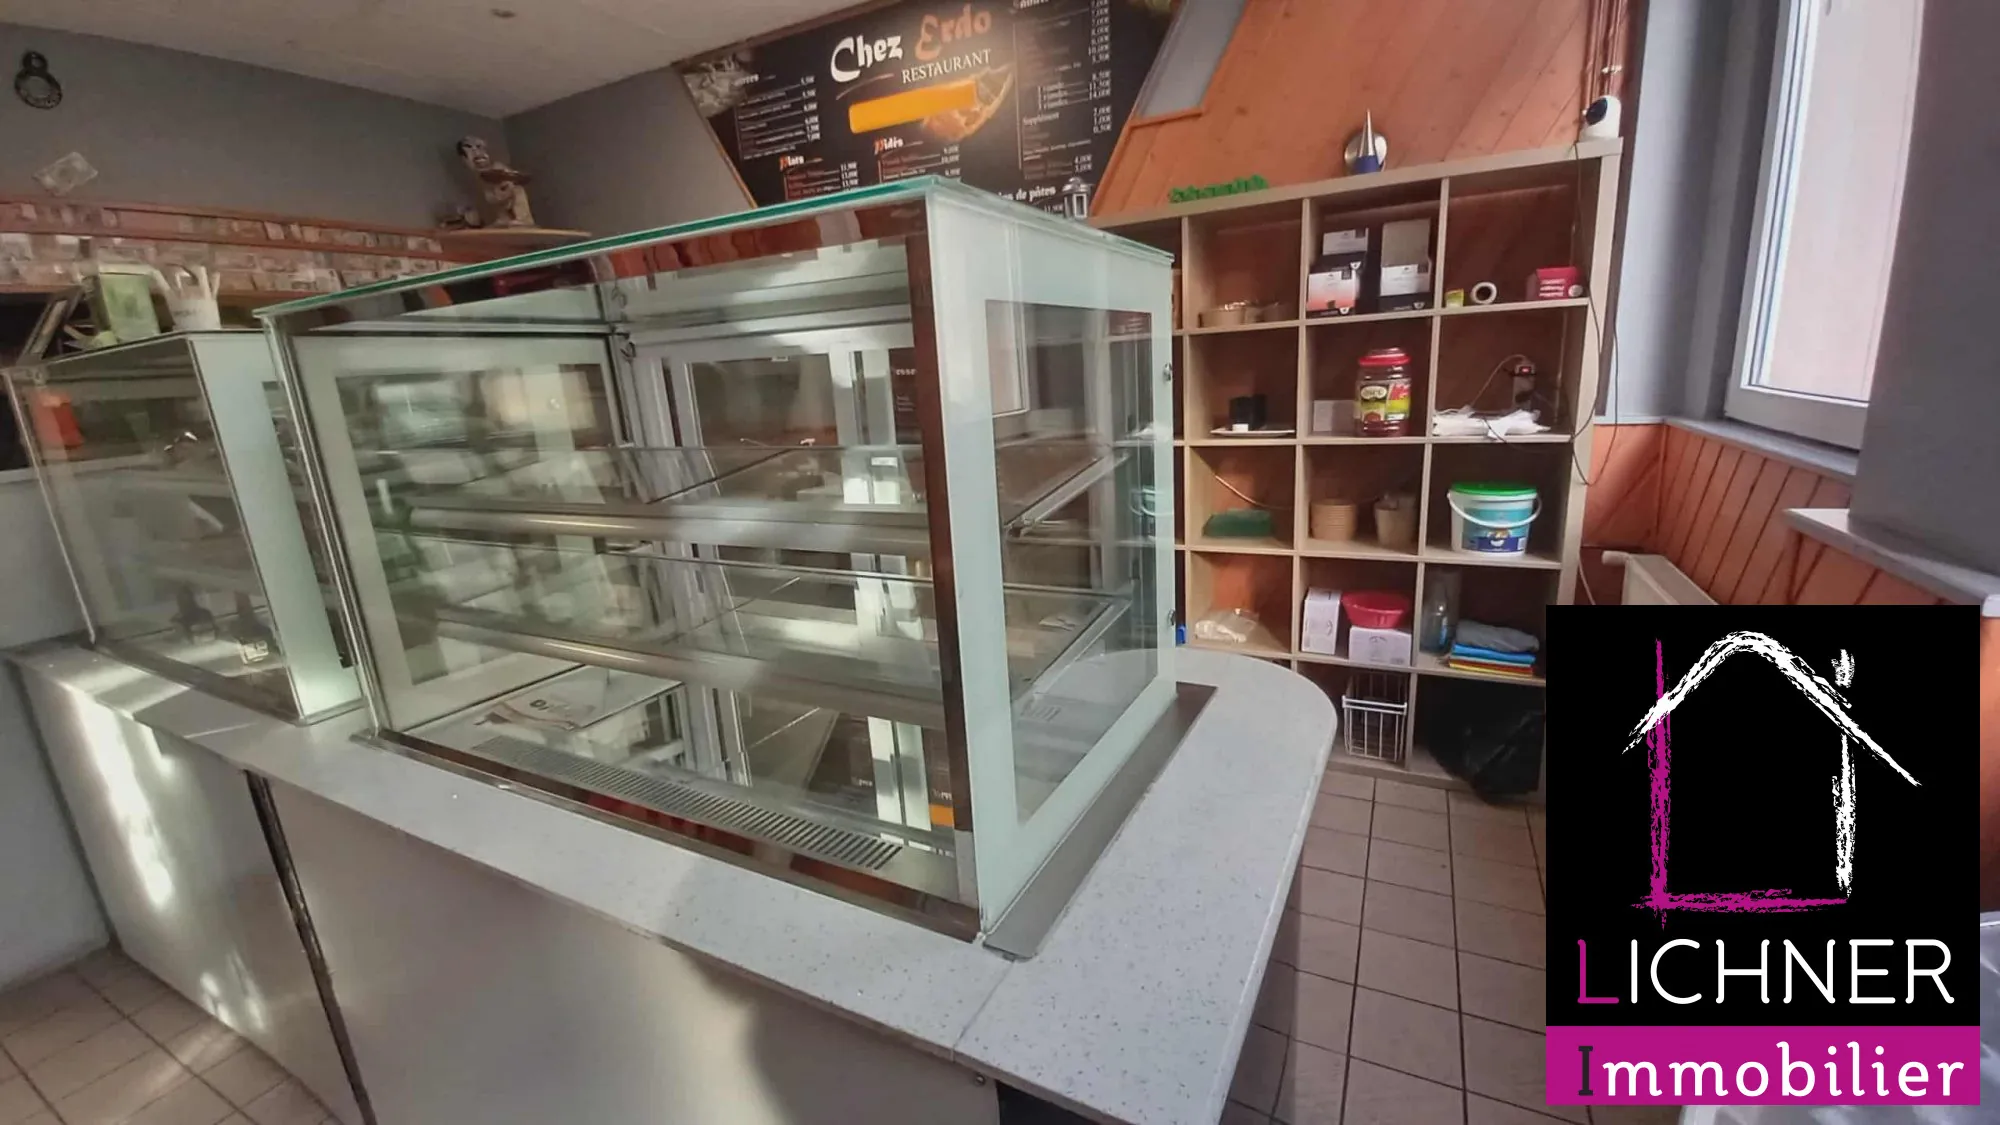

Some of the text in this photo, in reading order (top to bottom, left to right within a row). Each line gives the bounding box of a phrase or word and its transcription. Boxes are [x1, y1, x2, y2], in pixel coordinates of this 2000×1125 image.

[831, 4, 992, 82] Chez Erdo
[902, 49, 992, 84] RESTAURANT
[1016, 188, 1027, 201] de
[1029, 186, 1056, 202] pâtes
